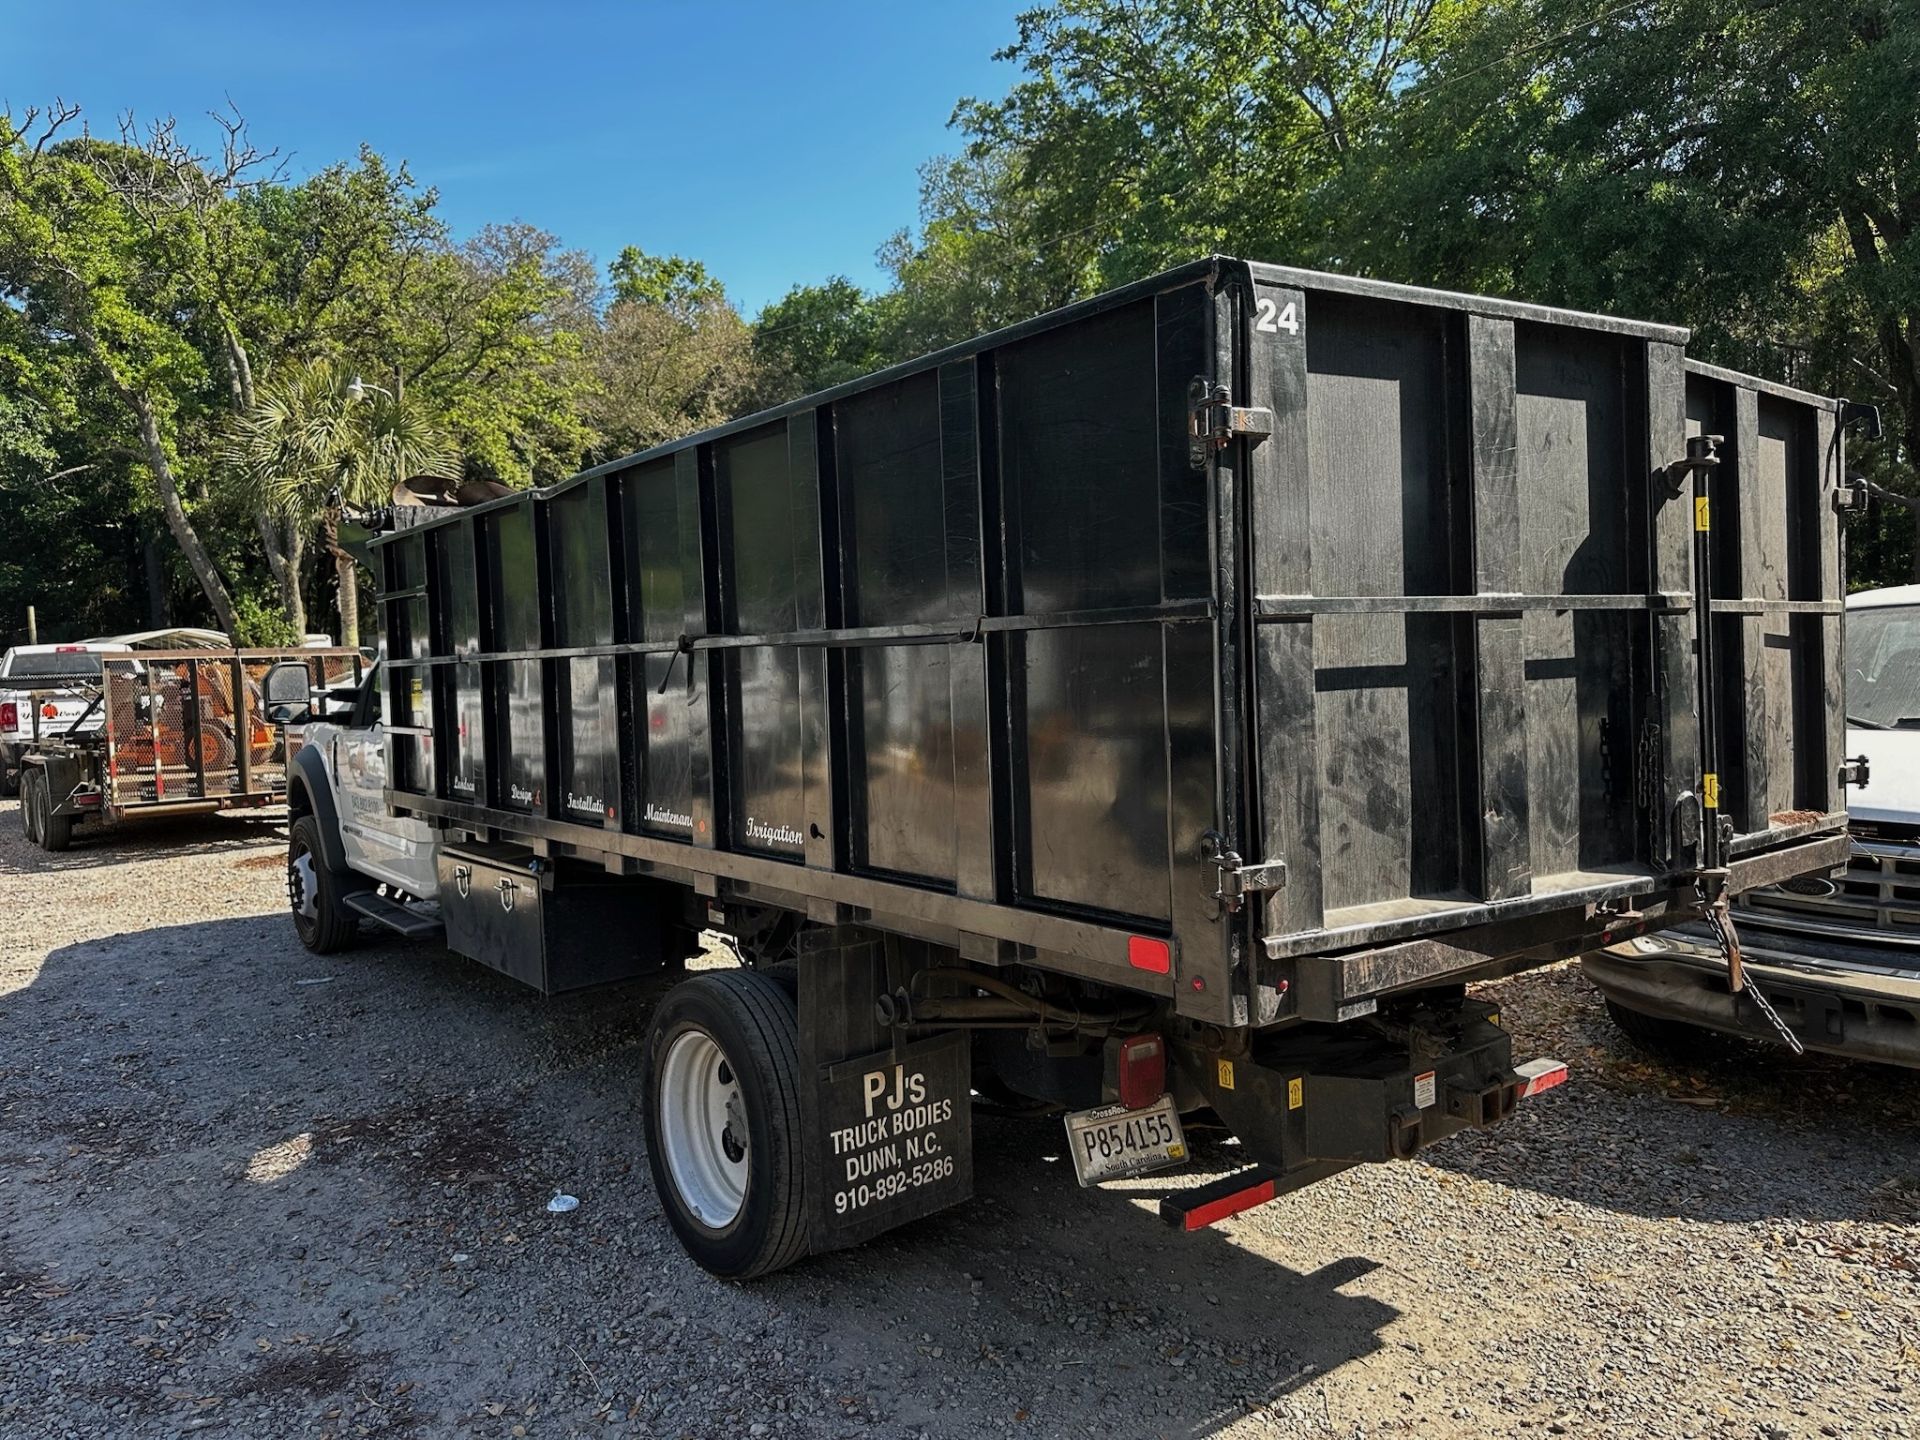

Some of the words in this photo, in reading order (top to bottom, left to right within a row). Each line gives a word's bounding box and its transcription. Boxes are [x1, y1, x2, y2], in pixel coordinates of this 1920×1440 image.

[1256, 298, 1300, 336] 24
[511, 784, 532, 805] Design
[566, 792, 605, 814] Installati
[746, 817, 803, 846] Irrigation
[863, 1064, 926, 1118] PJ's
[830, 1116, 888, 1154] TRUCK
[892, 1099, 952, 1136] BODIES
[1083, 1113, 1173, 1162] P854155
[846, 1144, 901, 1181] DUNN,
[906, 1132, 942, 1160] N.C.
[1105, 1160, 1128, 1173] South
[1130, 1152, 1162, 1166] Carolina
[834, 1156, 954, 1214] 910-892-5286
